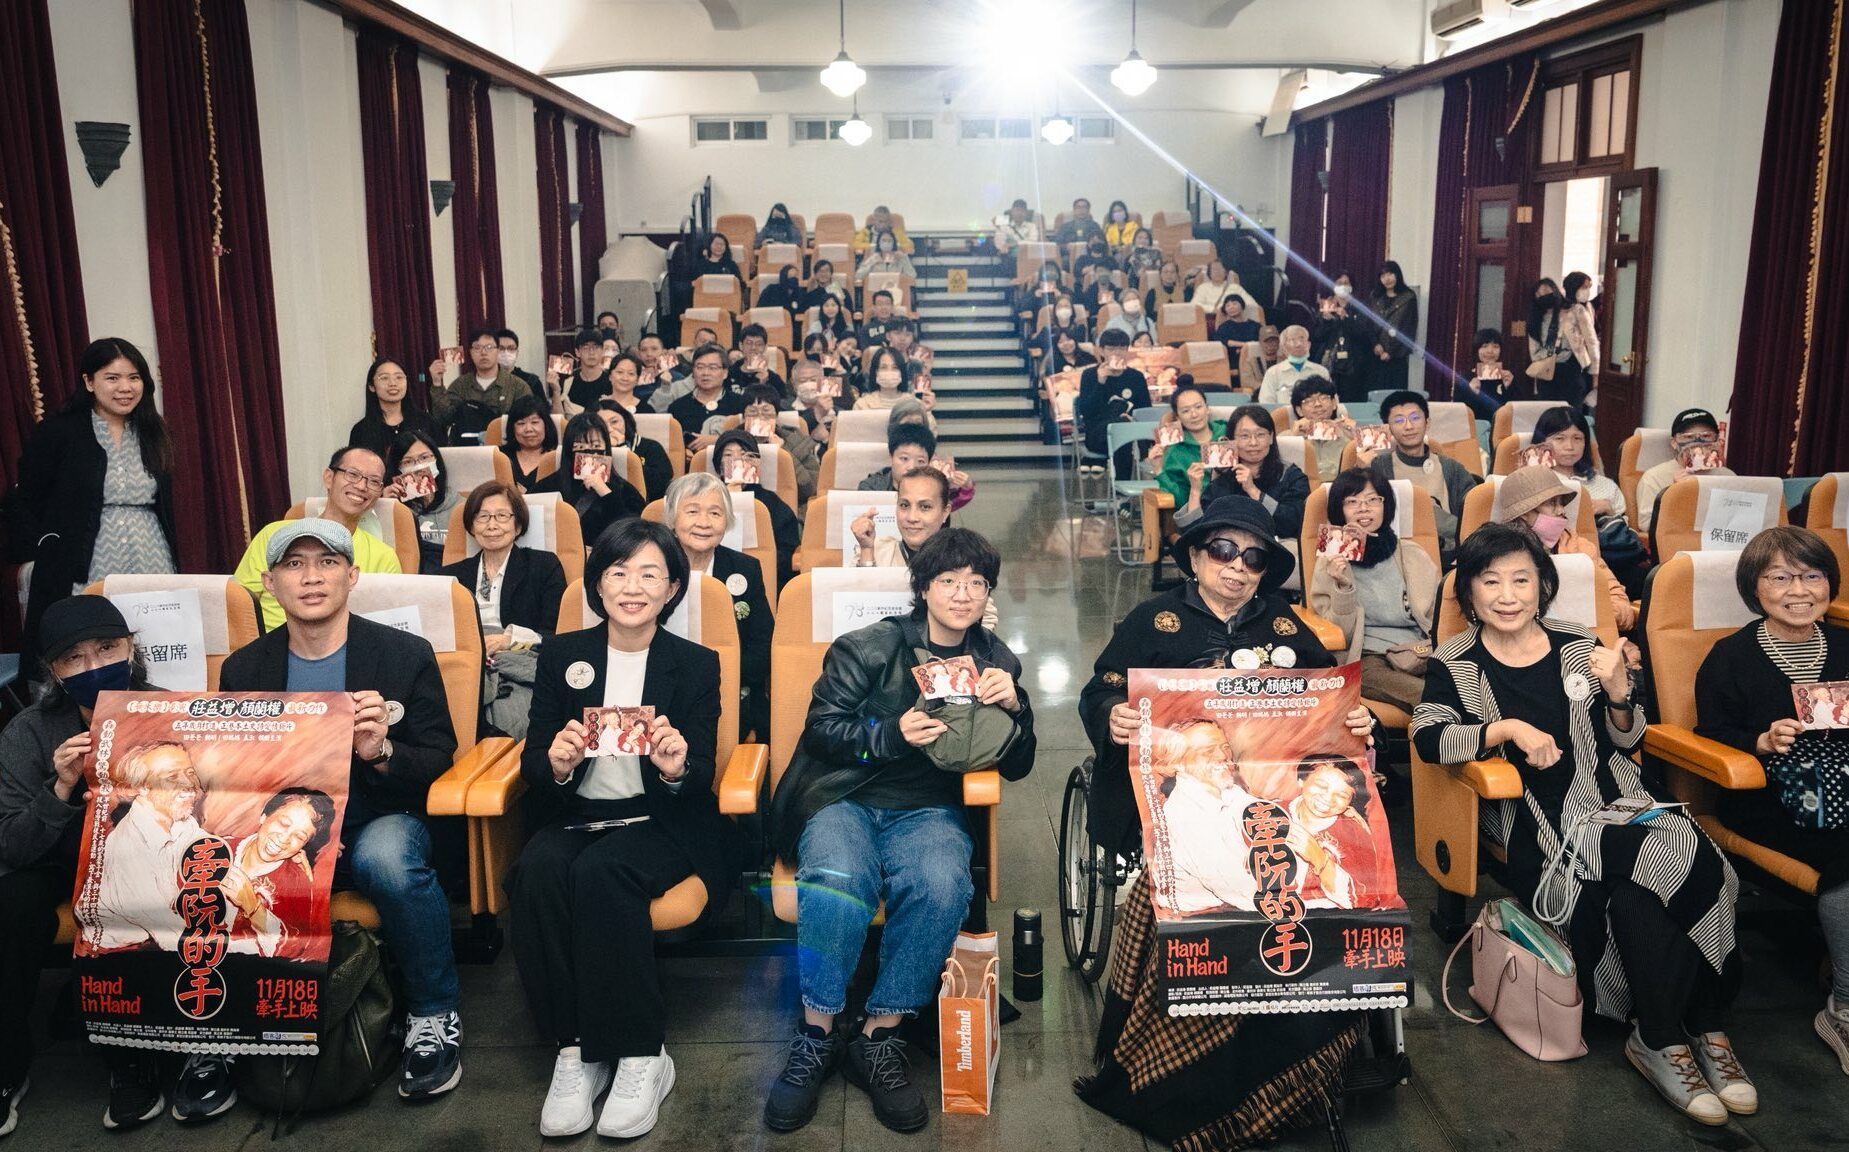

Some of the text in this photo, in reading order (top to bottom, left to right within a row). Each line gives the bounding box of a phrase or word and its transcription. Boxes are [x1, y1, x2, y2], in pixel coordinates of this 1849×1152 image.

[1711, 528, 1749, 544] 保留席
[1219, 679, 1260, 694] 莊益增
[1265, 678, 1306, 694] 顏蘭權
[191, 701, 236, 716] 莊益增
[239, 701, 283, 716] 顏蘭權
[1245, 802, 1308, 972] 牽阮的手
[178, 840, 231, 1015] 牽阮的手
[1167, 938, 1210, 957] Hand
[1342, 927, 1404, 949] 11月18日
[1167, 956, 1228, 977] in Hand
[1343, 949, 1405, 970] 牽手上映
[81, 976, 123, 995] Hand
[256, 978, 318, 1001] 11月18日
[82, 996, 141, 1014] in Hand
[255, 1000, 318, 1020] 牽手上映
[956, 1009, 973, 1072] Timberland
